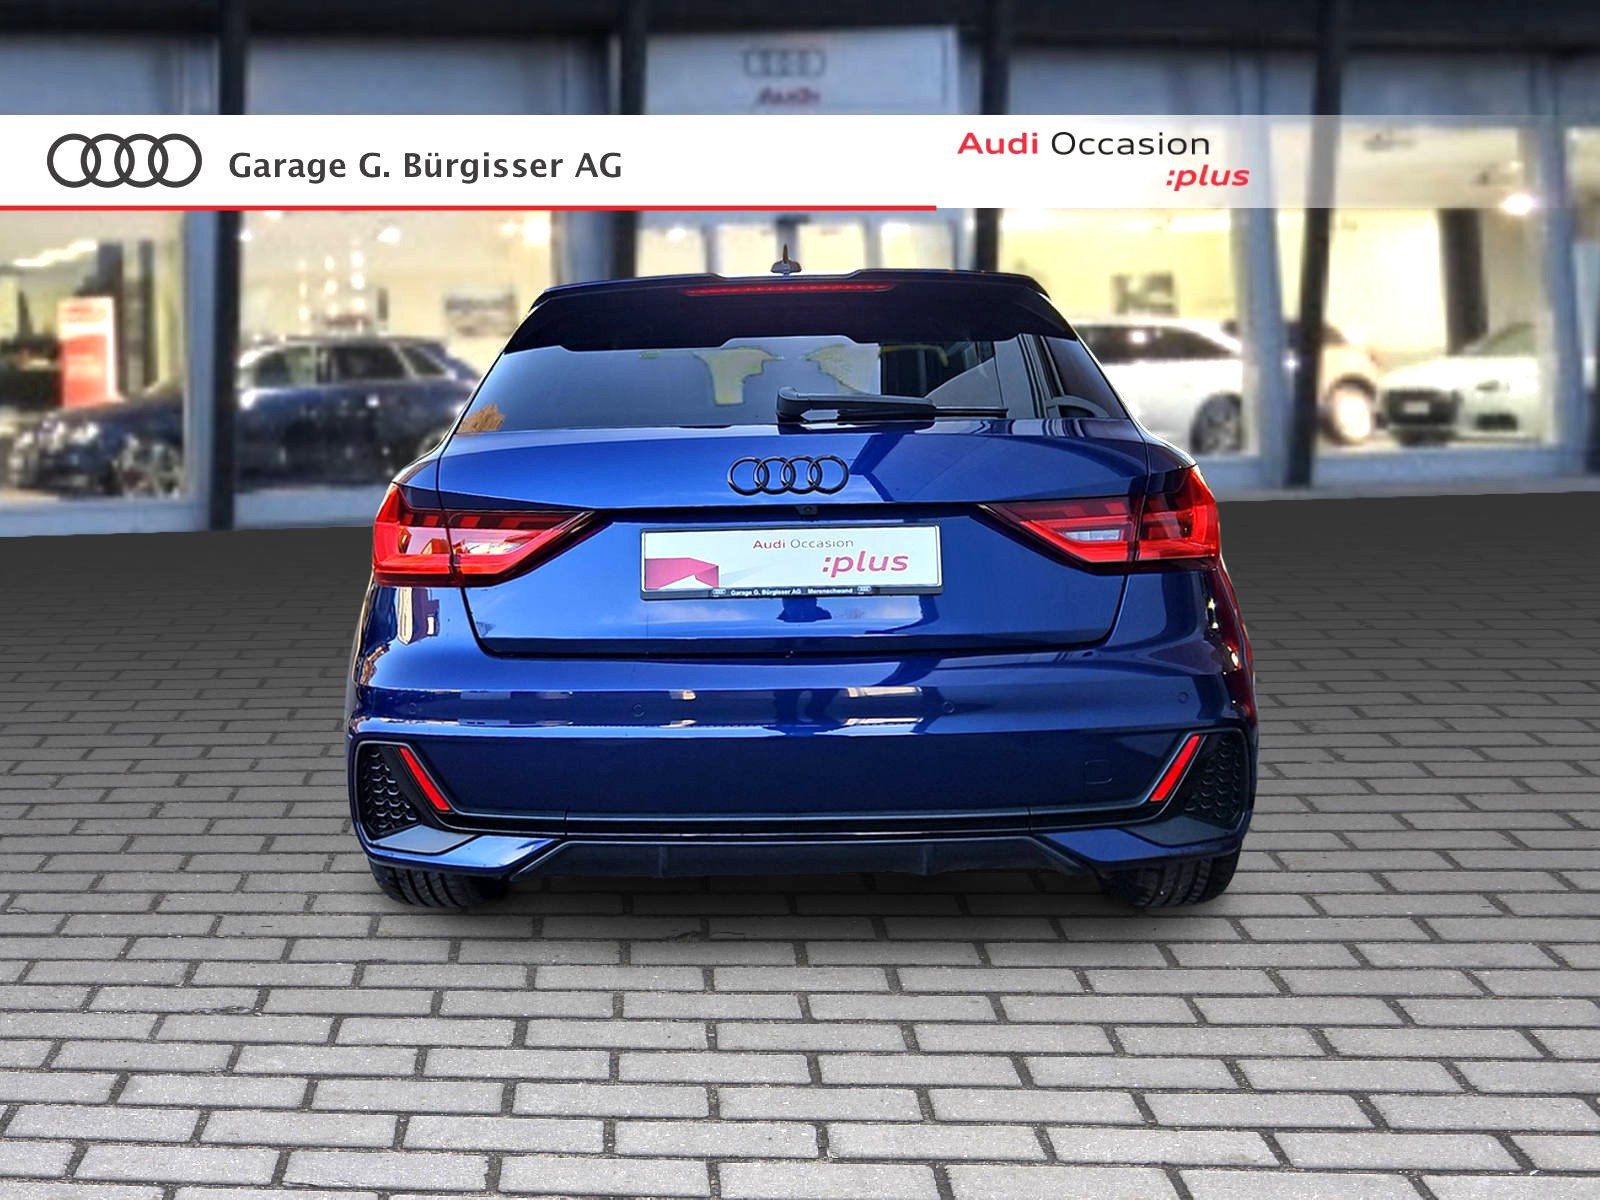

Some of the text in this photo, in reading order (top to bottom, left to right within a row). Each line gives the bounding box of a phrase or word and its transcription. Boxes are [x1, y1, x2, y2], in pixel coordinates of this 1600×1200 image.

[752, 538, 854, 550] Audi Occasion
[822, 550, 909, 578] :plus
[730, 588, 752, 597] Garage
[791, 588, 802, 596] AG
